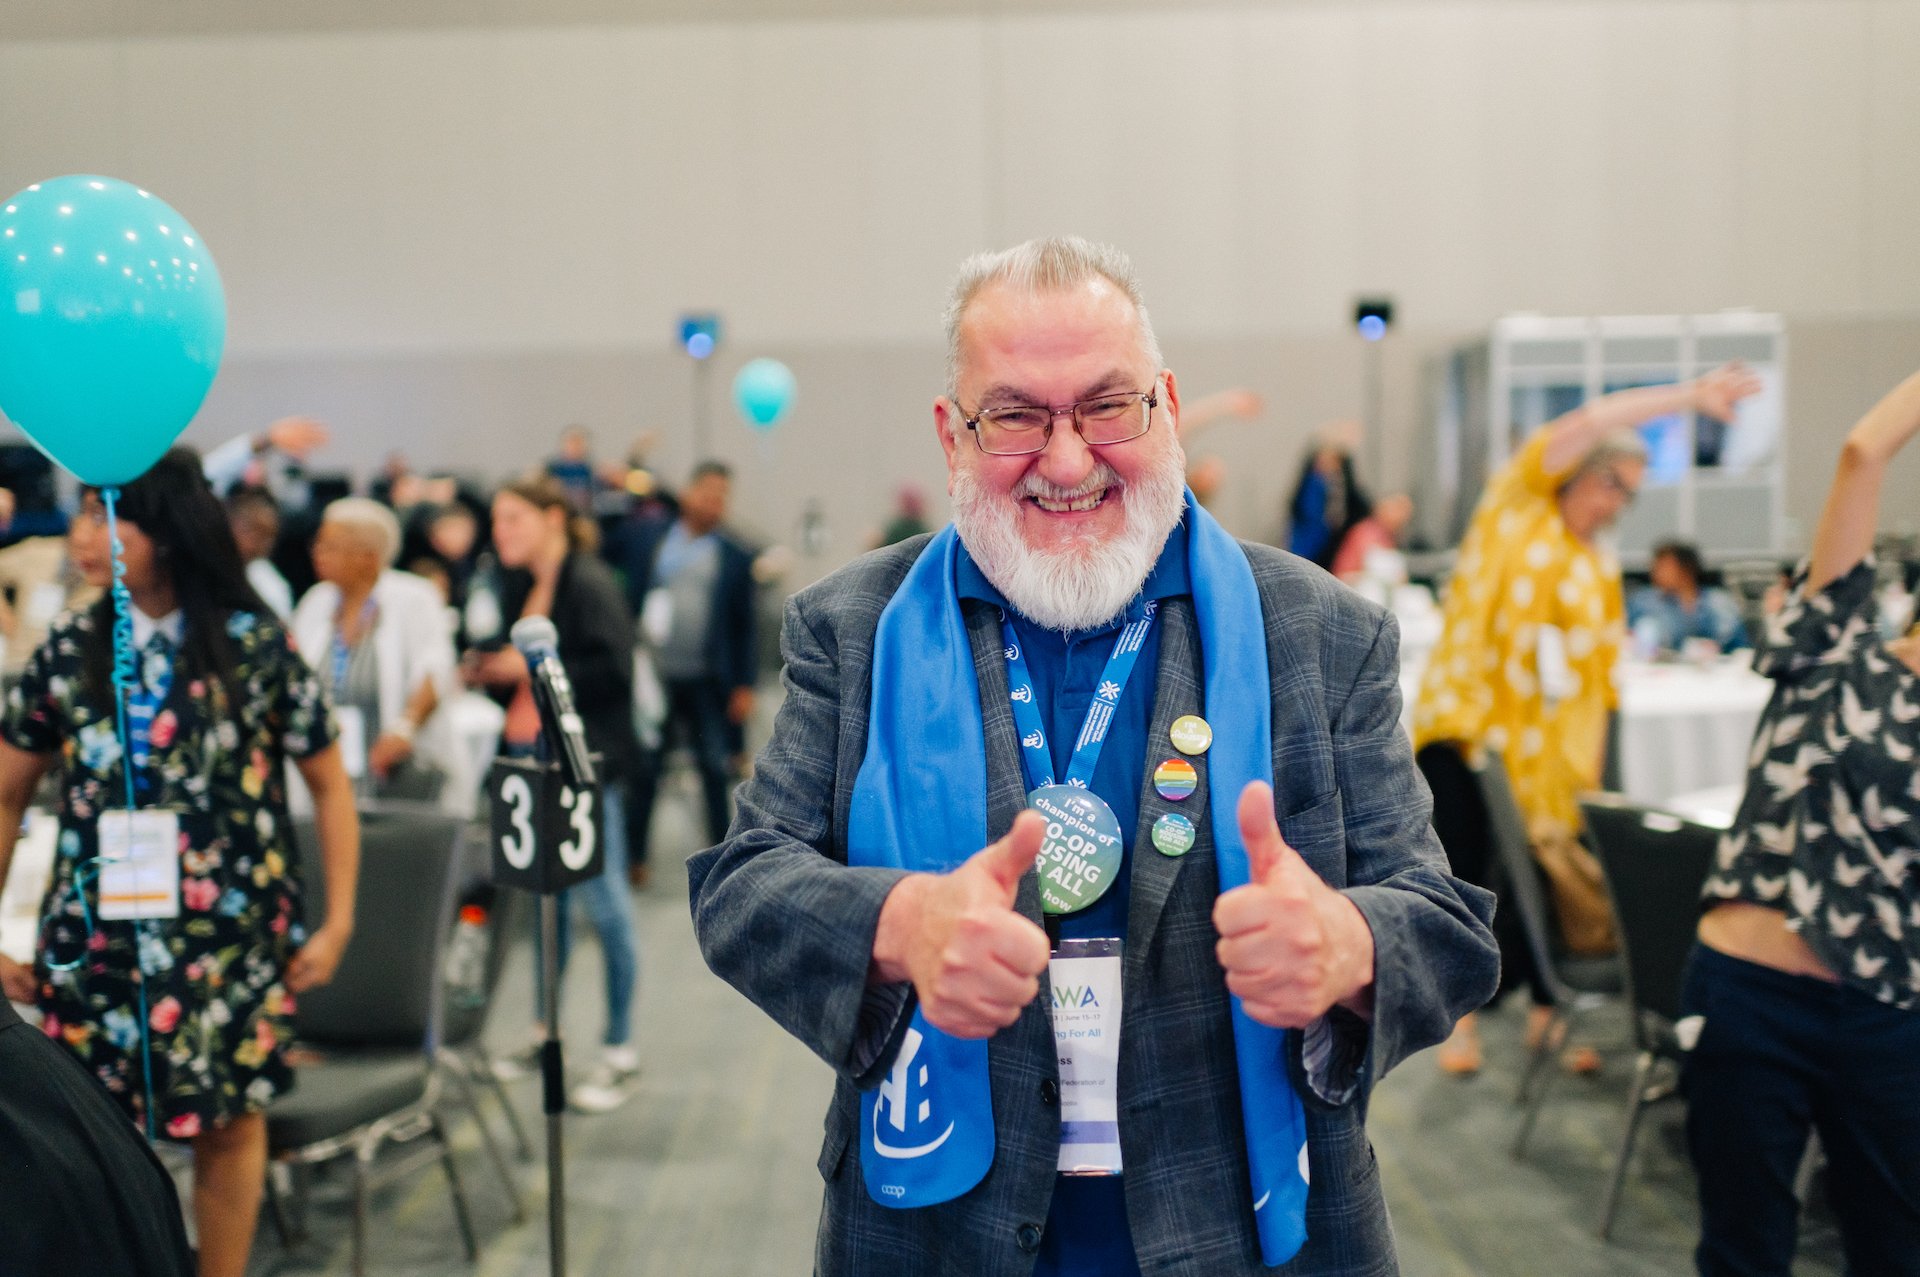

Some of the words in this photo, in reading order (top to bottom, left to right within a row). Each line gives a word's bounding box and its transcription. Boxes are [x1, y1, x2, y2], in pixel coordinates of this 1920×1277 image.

[501, 774, 535, 870] 3
[1035, 798, 1096, 837] champion
[1098, 834, 1116, 847] of
[1064, 798, 1085, 816] I'm
[1087, 813, 1096, 823] a
[559, 785, 596, 871] 3
[1039, 837, 1101, 884] USING
[1046, 866, 1083, 897] ALL
[1043, 888, 1072, 912] how
[1070, 1029, 1085, 1037] For
[1088, 1028, 1101, 1037] All
[1059, 1057, 1072, 1065] ss
